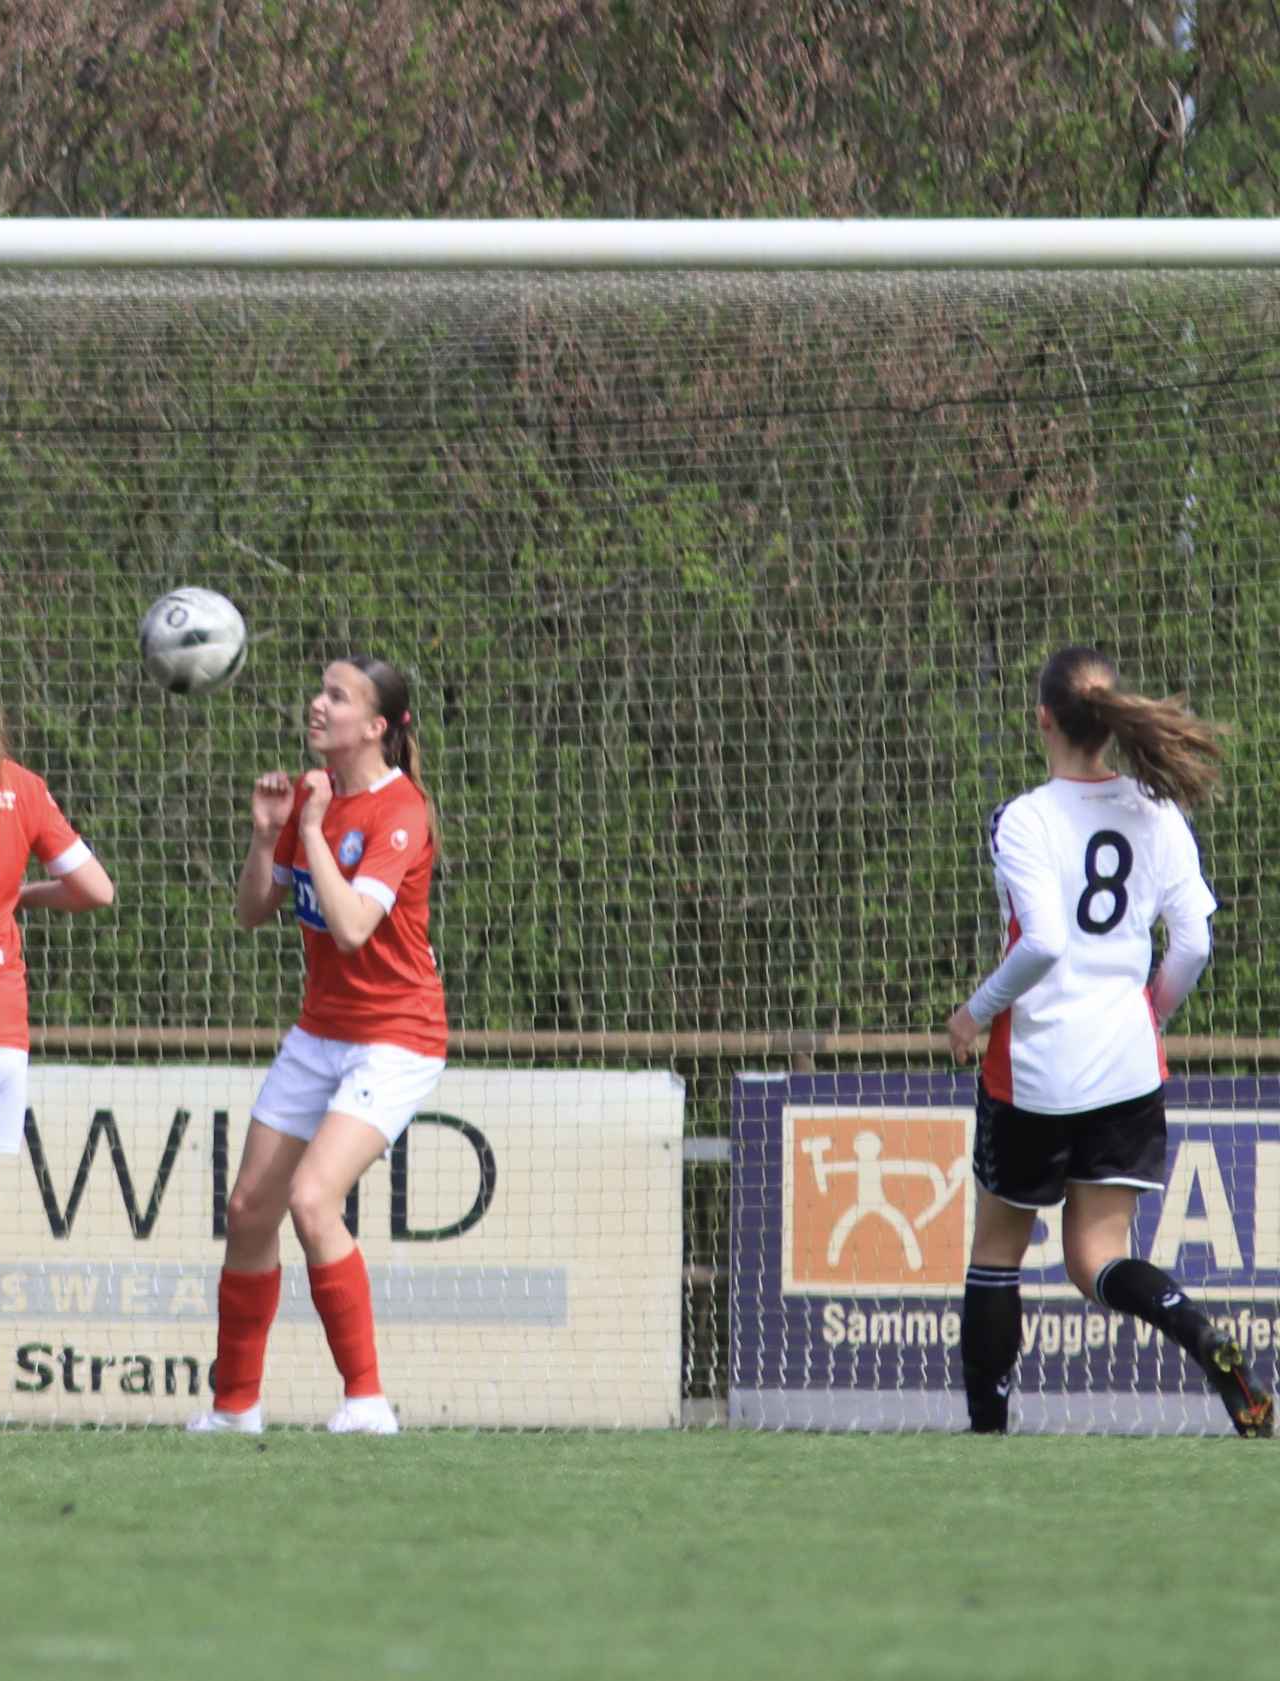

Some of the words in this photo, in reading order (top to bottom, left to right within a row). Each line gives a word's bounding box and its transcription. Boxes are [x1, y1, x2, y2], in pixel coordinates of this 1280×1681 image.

[1077, 829, 1133, 935] 8
[822, 1303, 962, 1346] Samme
[1020, 1310, 1125, 1356] ygger
[15, 1342, 219, 1395] Stran
